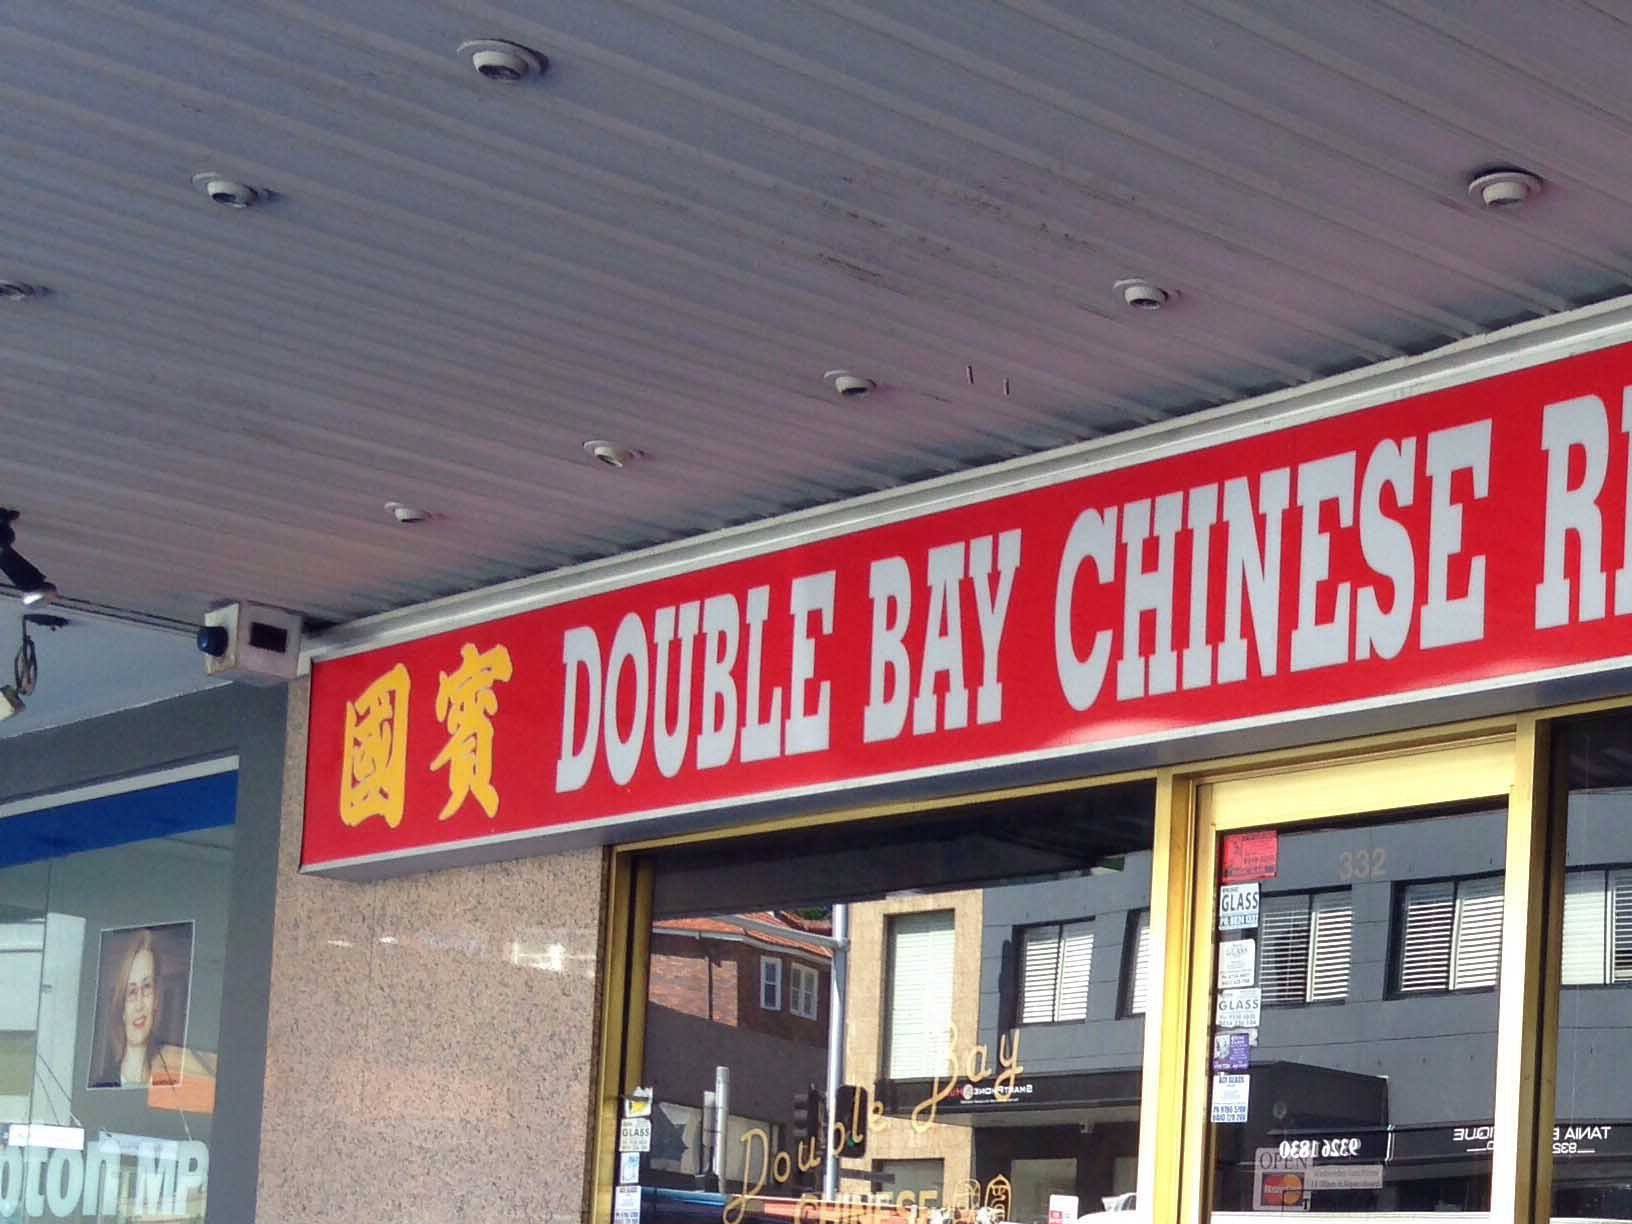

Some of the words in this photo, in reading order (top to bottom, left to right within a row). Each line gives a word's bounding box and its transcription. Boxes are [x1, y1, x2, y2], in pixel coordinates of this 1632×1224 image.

[555, 570, 837, 793] DOUBLE
[863, 529, 1022, 743] BAY
[1054, 418, 1493, 712] CHINESE
[1338, 848, 1388, 882] 332
[1222, 892, 1258, 912] GLASS
[1219, 1000, 1259, 1010] GLASS
[622, 1127, 650, 1137] GLASS
[1260, 1152, 1308, 1170] OPEN
[134, 1140, 209, 1216] MP
